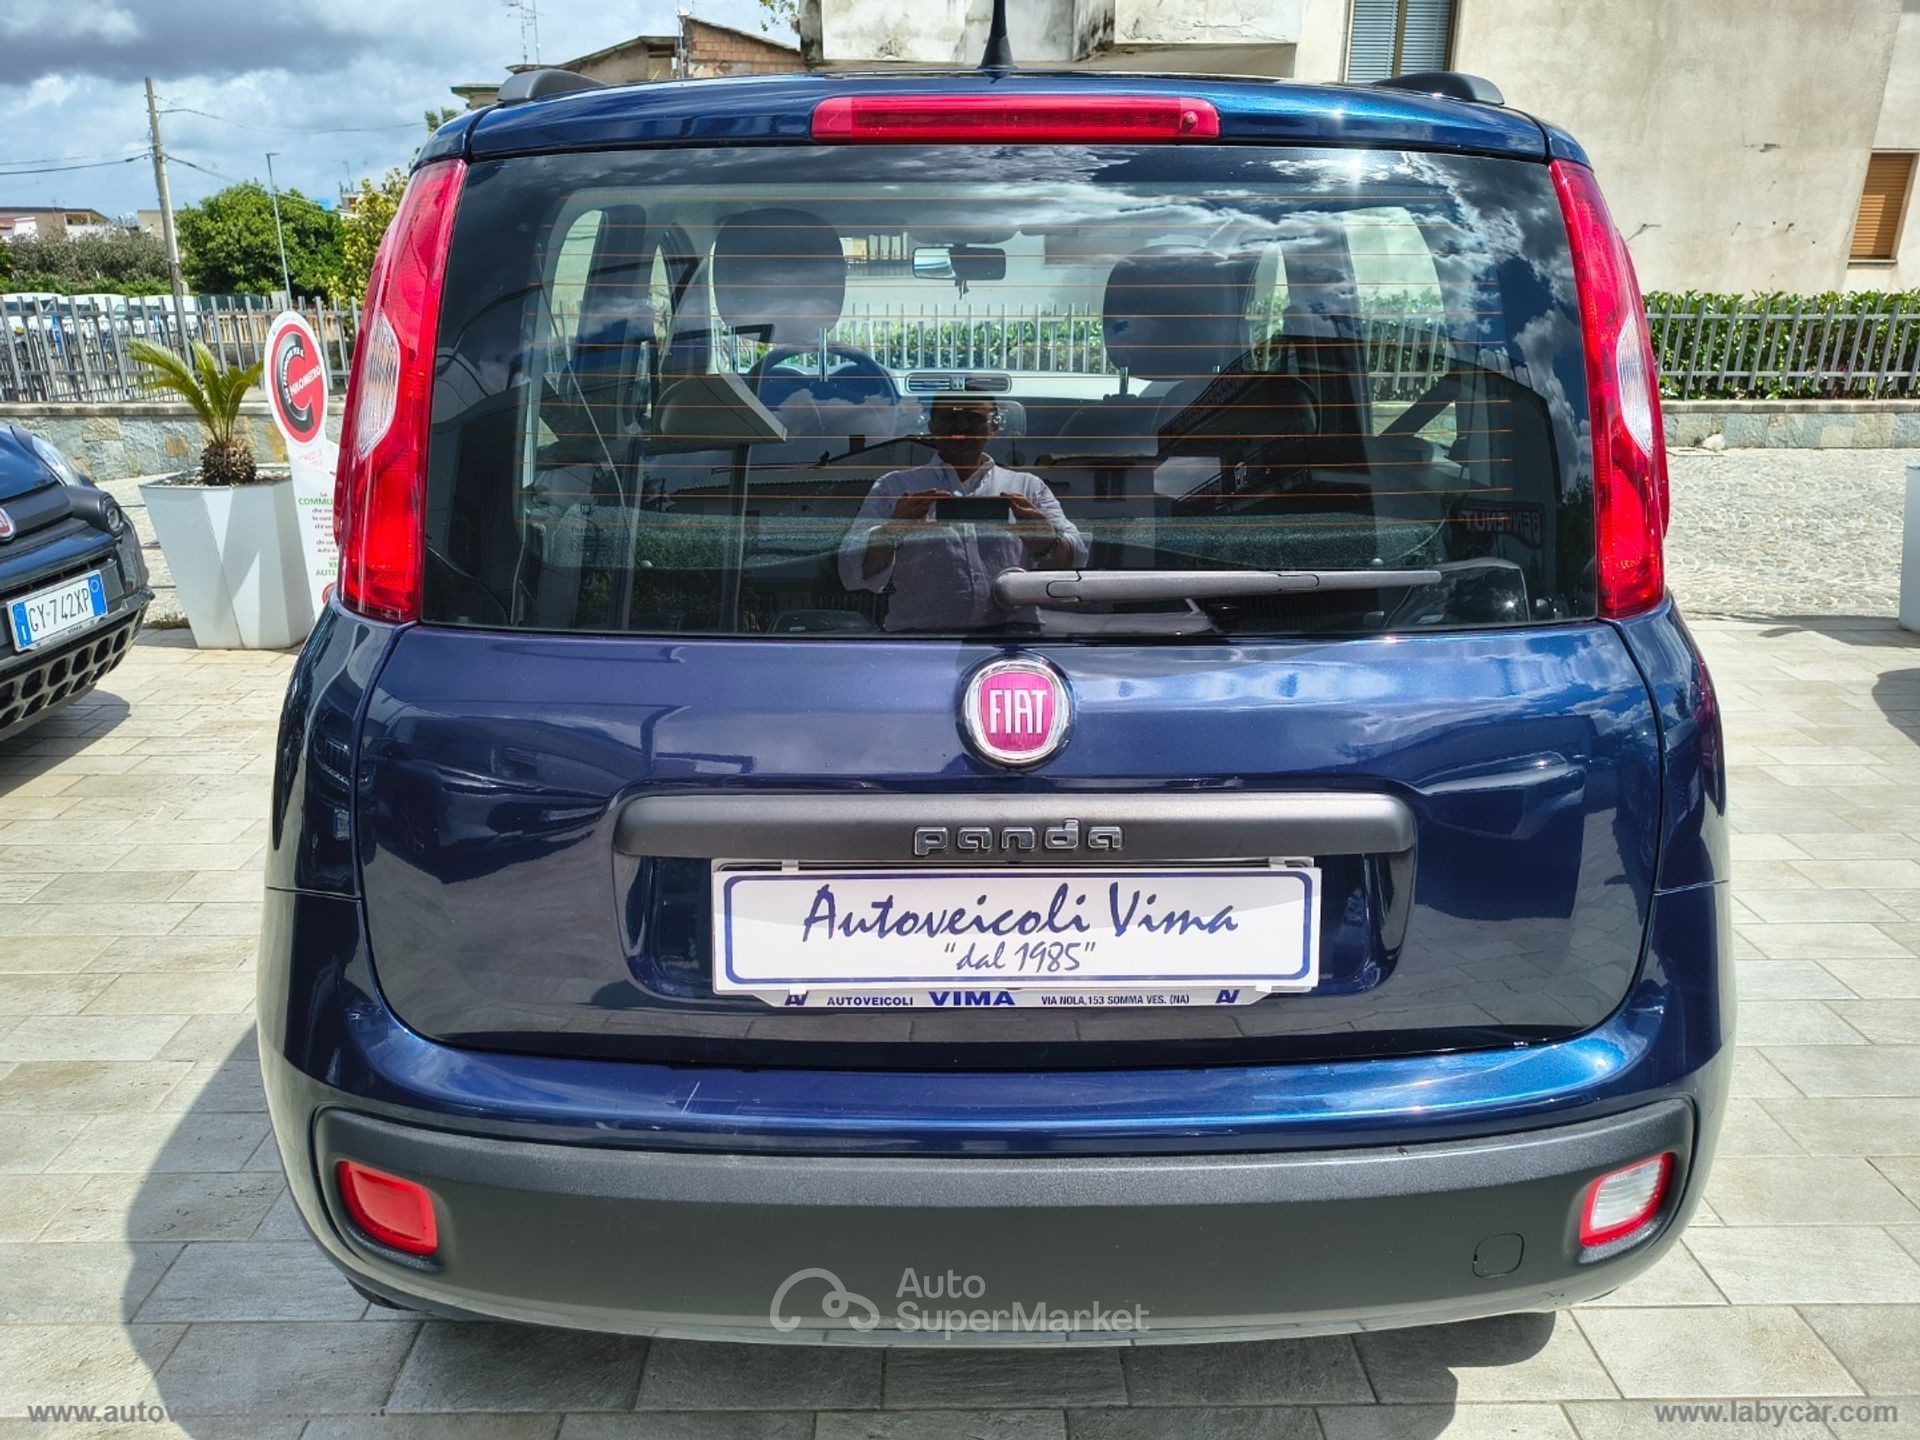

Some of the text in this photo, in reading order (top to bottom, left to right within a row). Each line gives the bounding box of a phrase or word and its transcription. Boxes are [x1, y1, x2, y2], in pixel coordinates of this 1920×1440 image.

[989, 689, 1048, 734] FIAT
[914, 818, 1123, 857] panda
[802, 881, 1239, 942] Autoveicoli Vima
[827, 996, 913, 1006] AUTOVEICOLI
[929, 990, 1015, 1006] VIMA
[1041, 995, 1057, 1005] VIA
[1107, 994, 1143, 1005] SOMMA
[1146, 993, 1167, 1004] VES.
[1169, 993, 1190, 1005] (NA)
